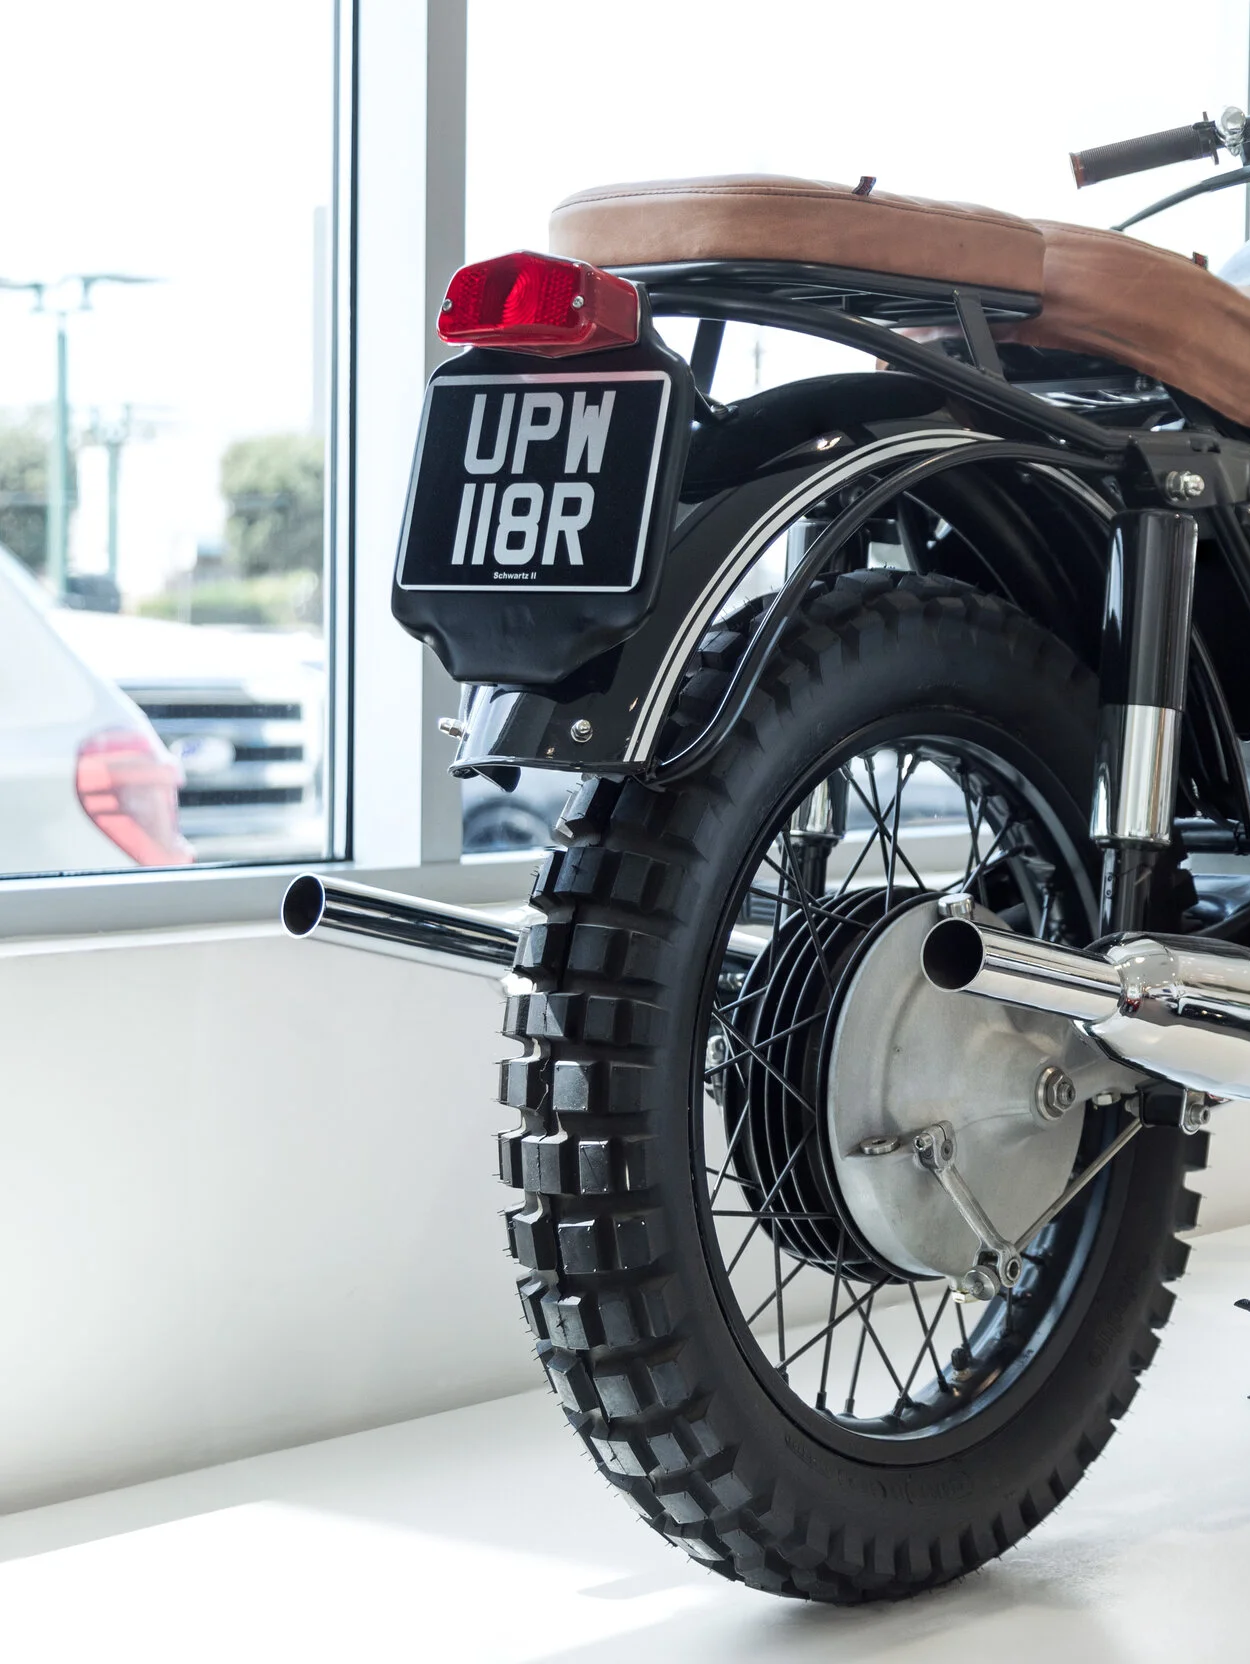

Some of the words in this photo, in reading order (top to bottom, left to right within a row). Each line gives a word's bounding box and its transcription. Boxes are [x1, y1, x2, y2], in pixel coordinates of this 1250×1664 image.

[463, 390, 617, 475] UPW
[450, 482, 595, 566] 118R
[493, 571, 529, 580] Schwartz
